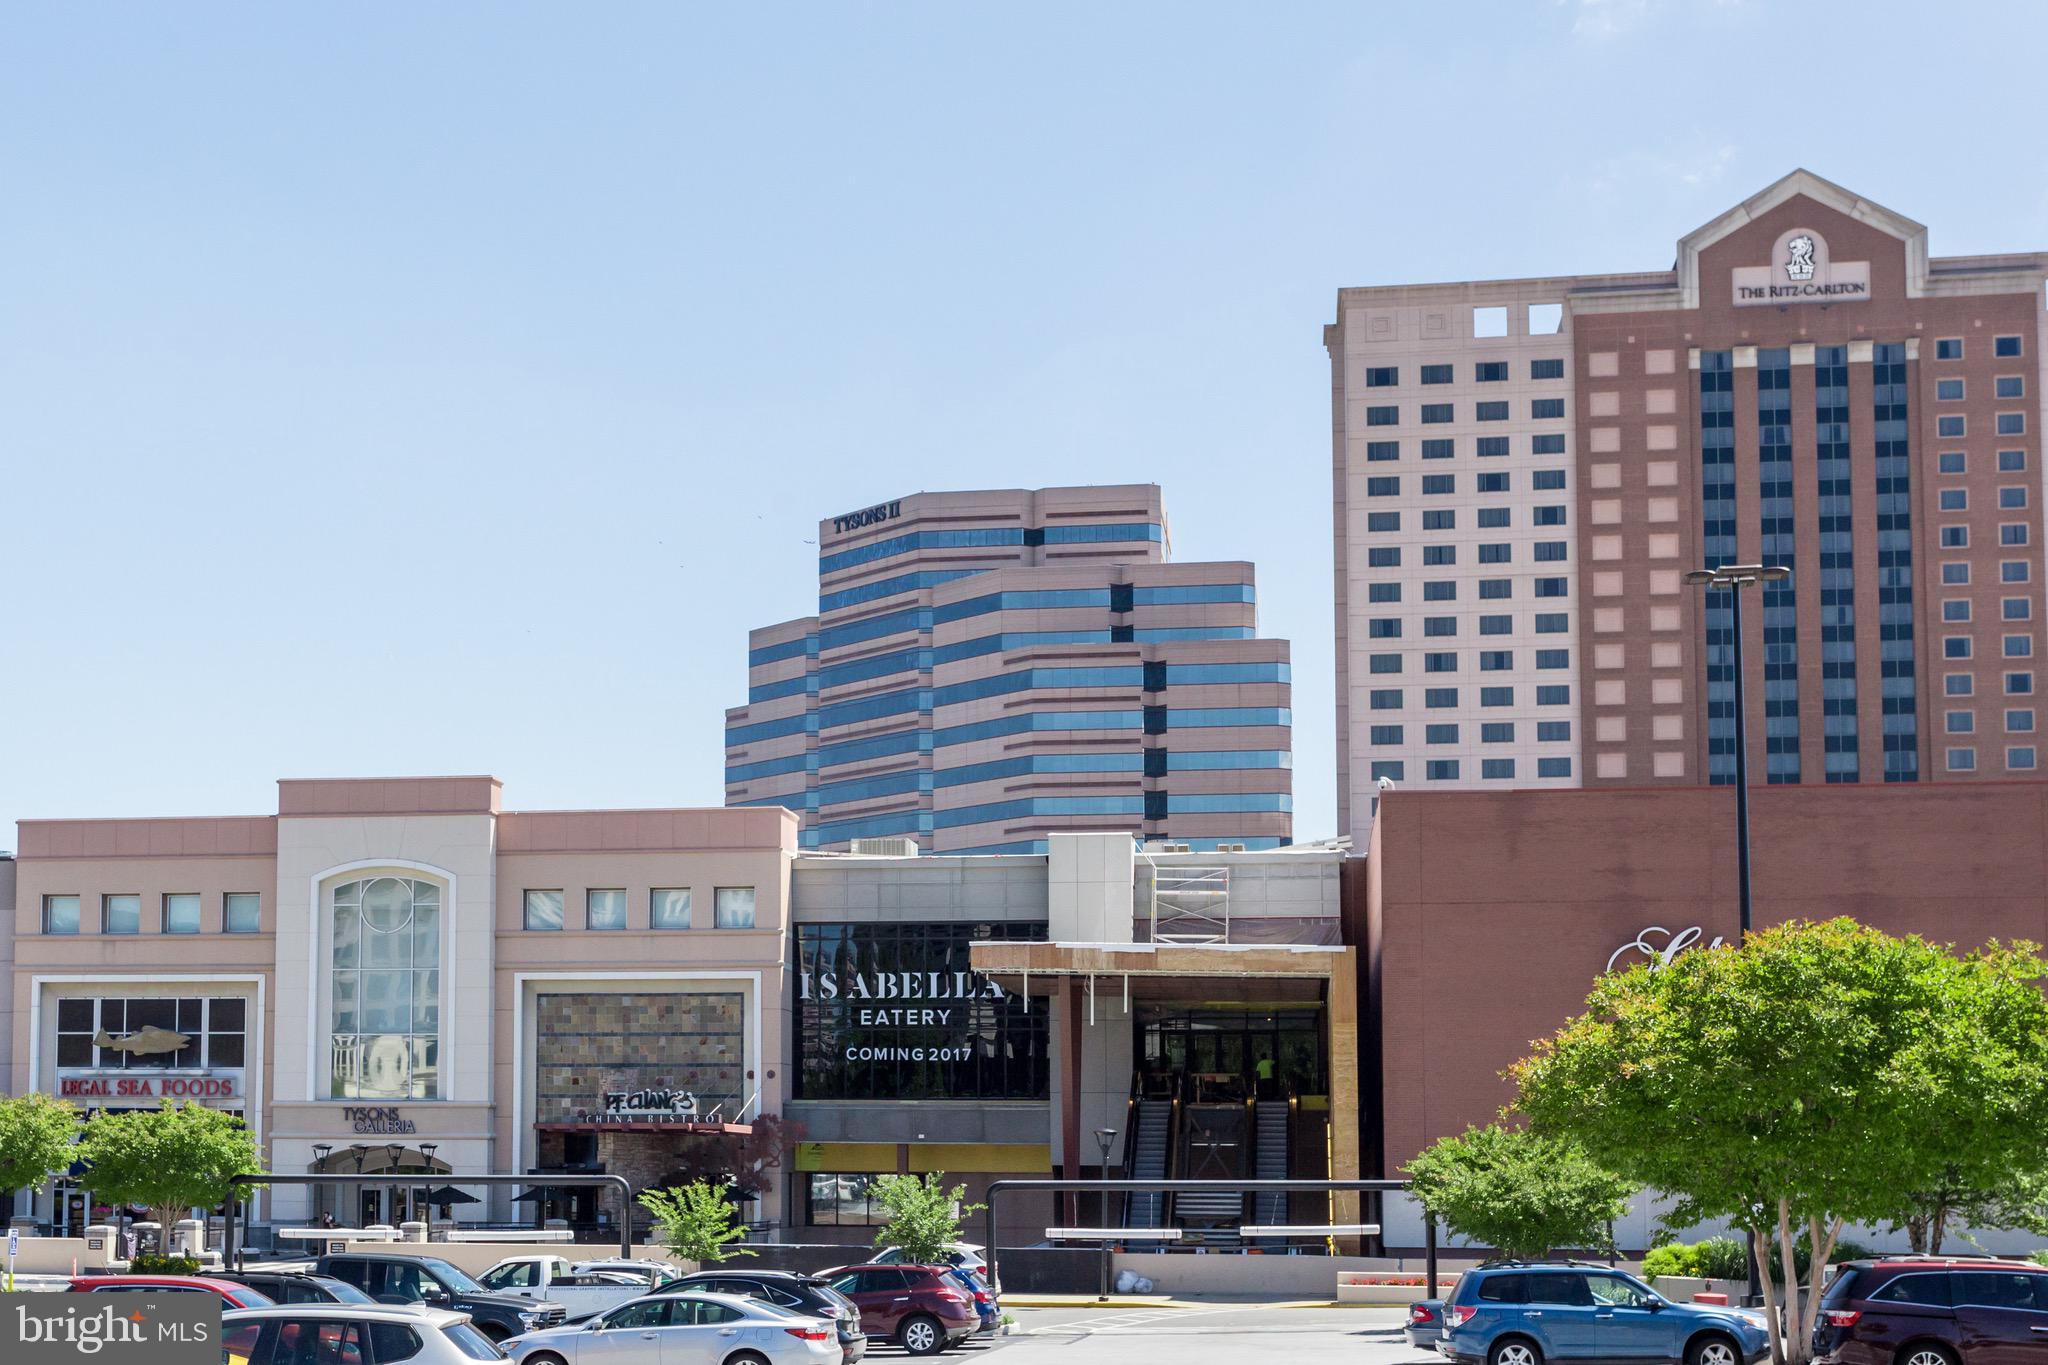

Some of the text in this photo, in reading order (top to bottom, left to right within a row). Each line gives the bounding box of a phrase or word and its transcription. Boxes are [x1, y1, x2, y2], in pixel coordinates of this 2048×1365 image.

[1738, 282, 1865, 299] THE RITZ-CARLTON
[834, 501, 901, 534] TYSONS II
[860, 1009, 951, 1025] EATERY
[846, 1047, 972, 1061] COMING 2017
[60, 1078, 233, 1096] LEGAL SEA FOODS
[343, 1107, 400, 1120] TYSONS
[586, 1114, 714, 1123] CHINA BISTRO
[353, 1120, 416, 1134] GALLERIA
